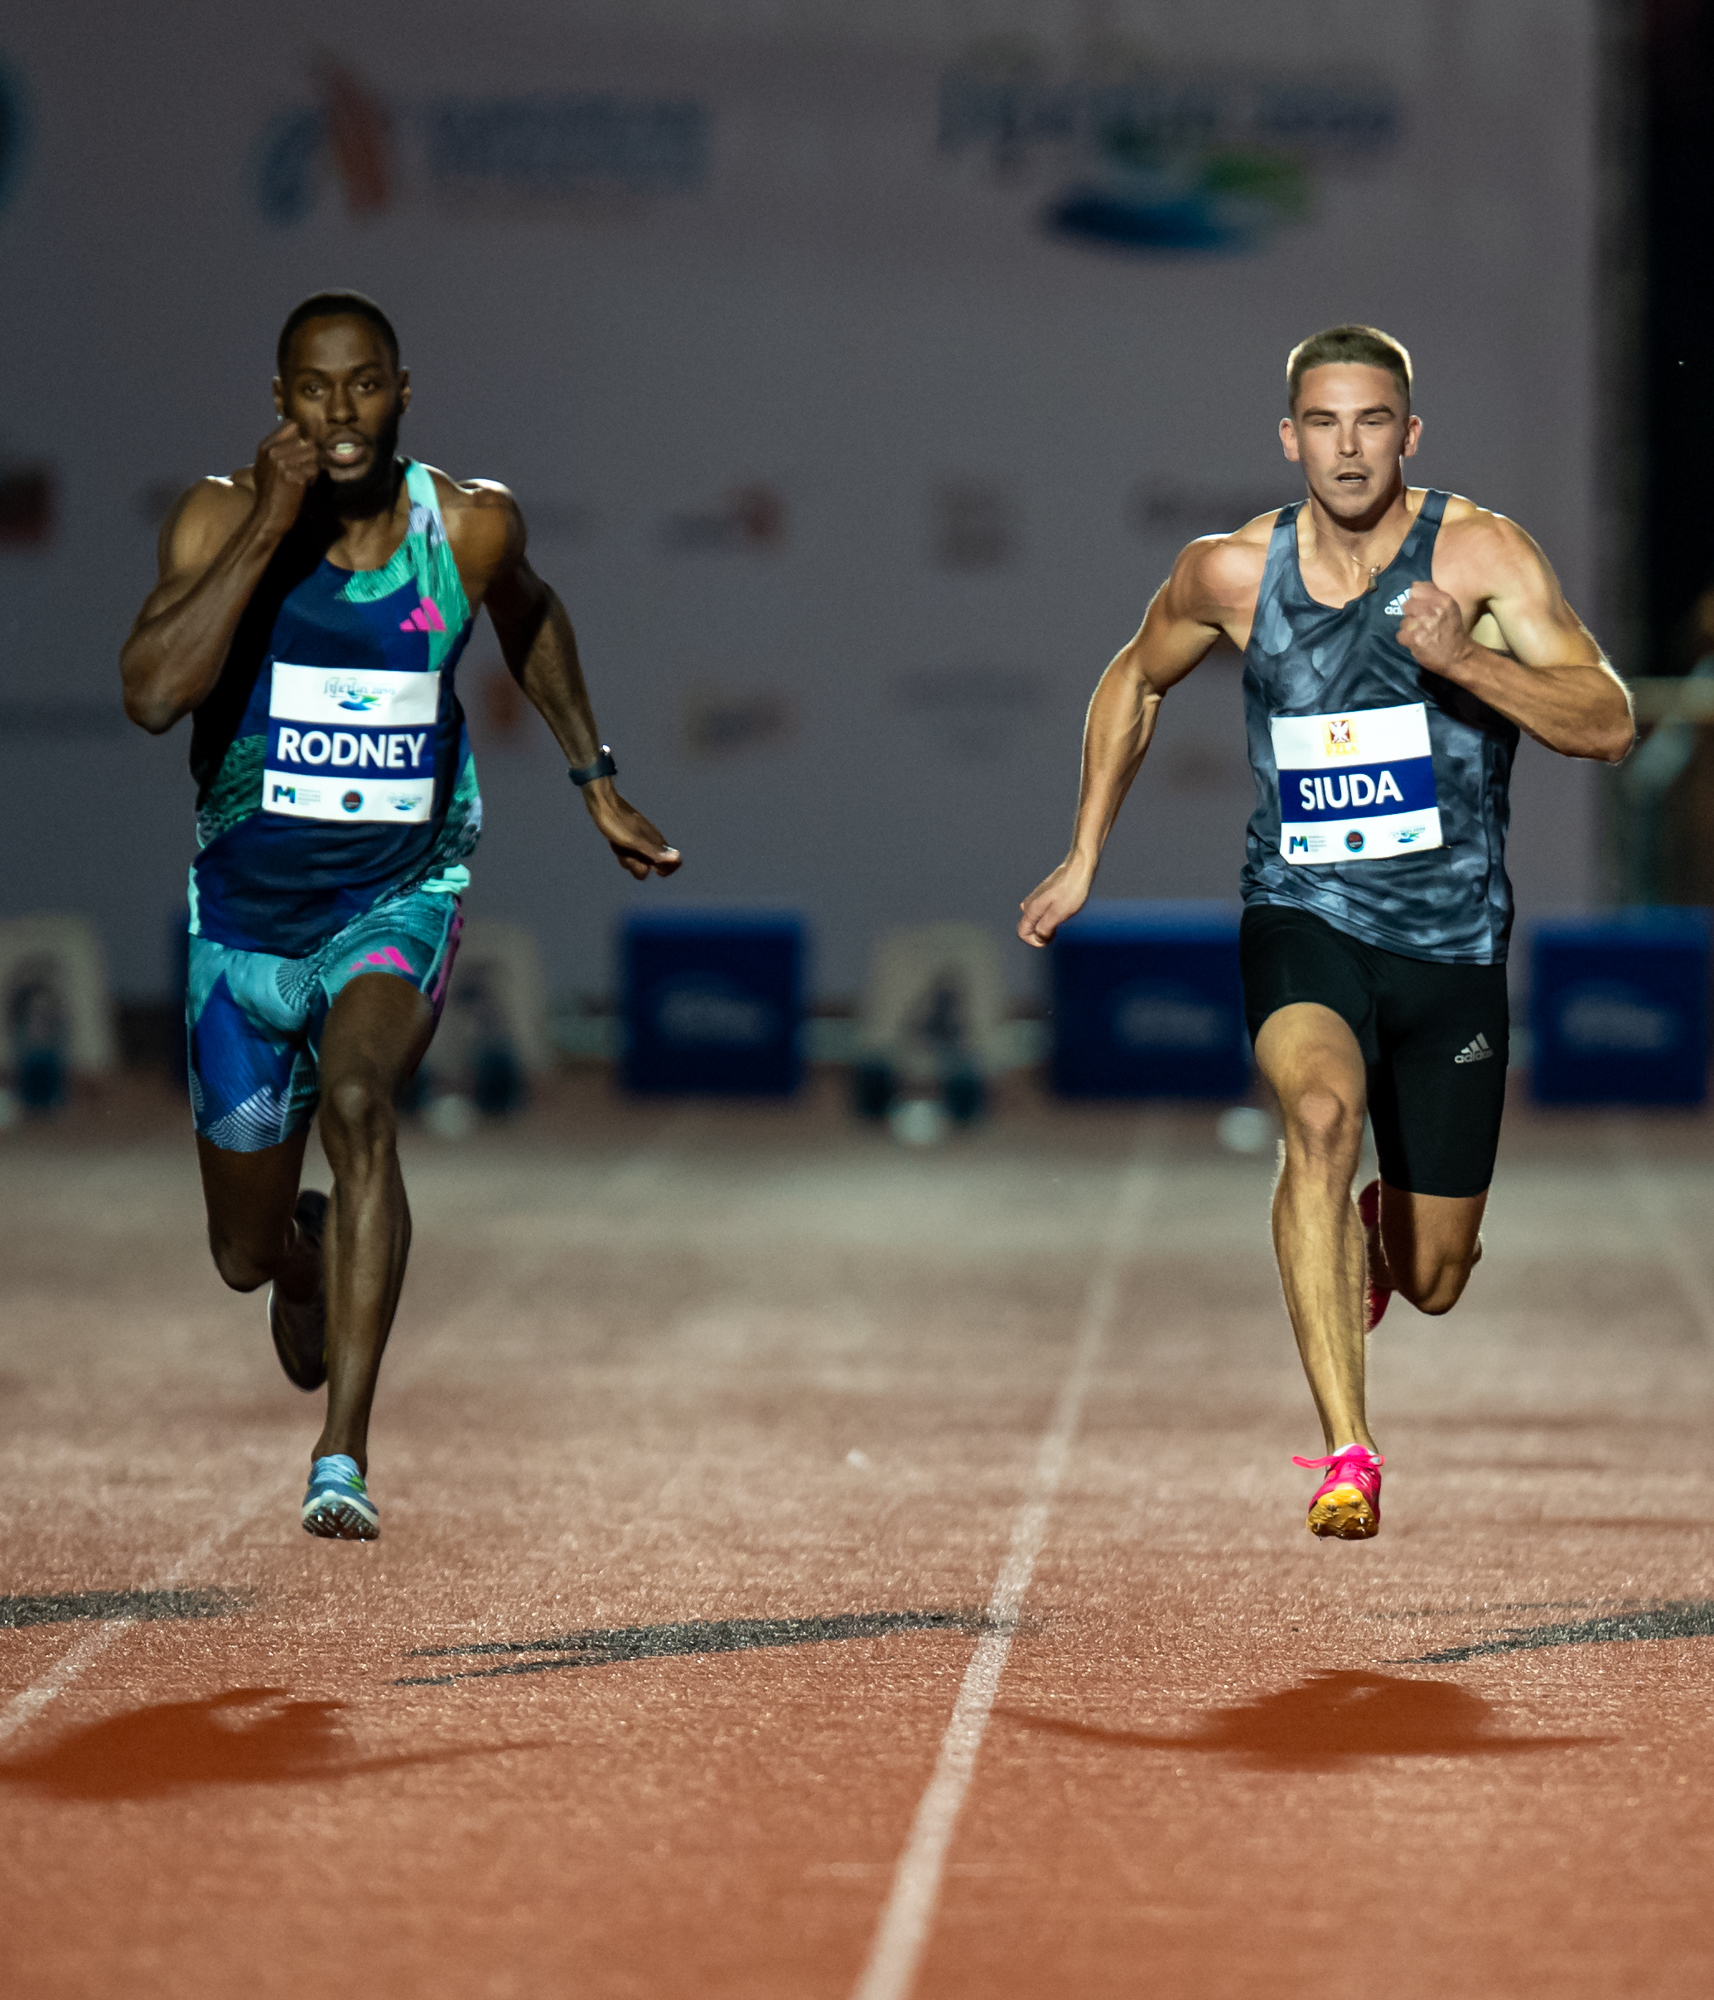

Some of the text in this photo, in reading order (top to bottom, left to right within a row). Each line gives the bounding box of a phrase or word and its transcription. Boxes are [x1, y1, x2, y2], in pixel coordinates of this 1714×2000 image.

[276, 726, 427, 769] RODNEY
[1299, 770, 1404, 811] SIUDA
[1454, 1048, 1493, 1064] adidas
